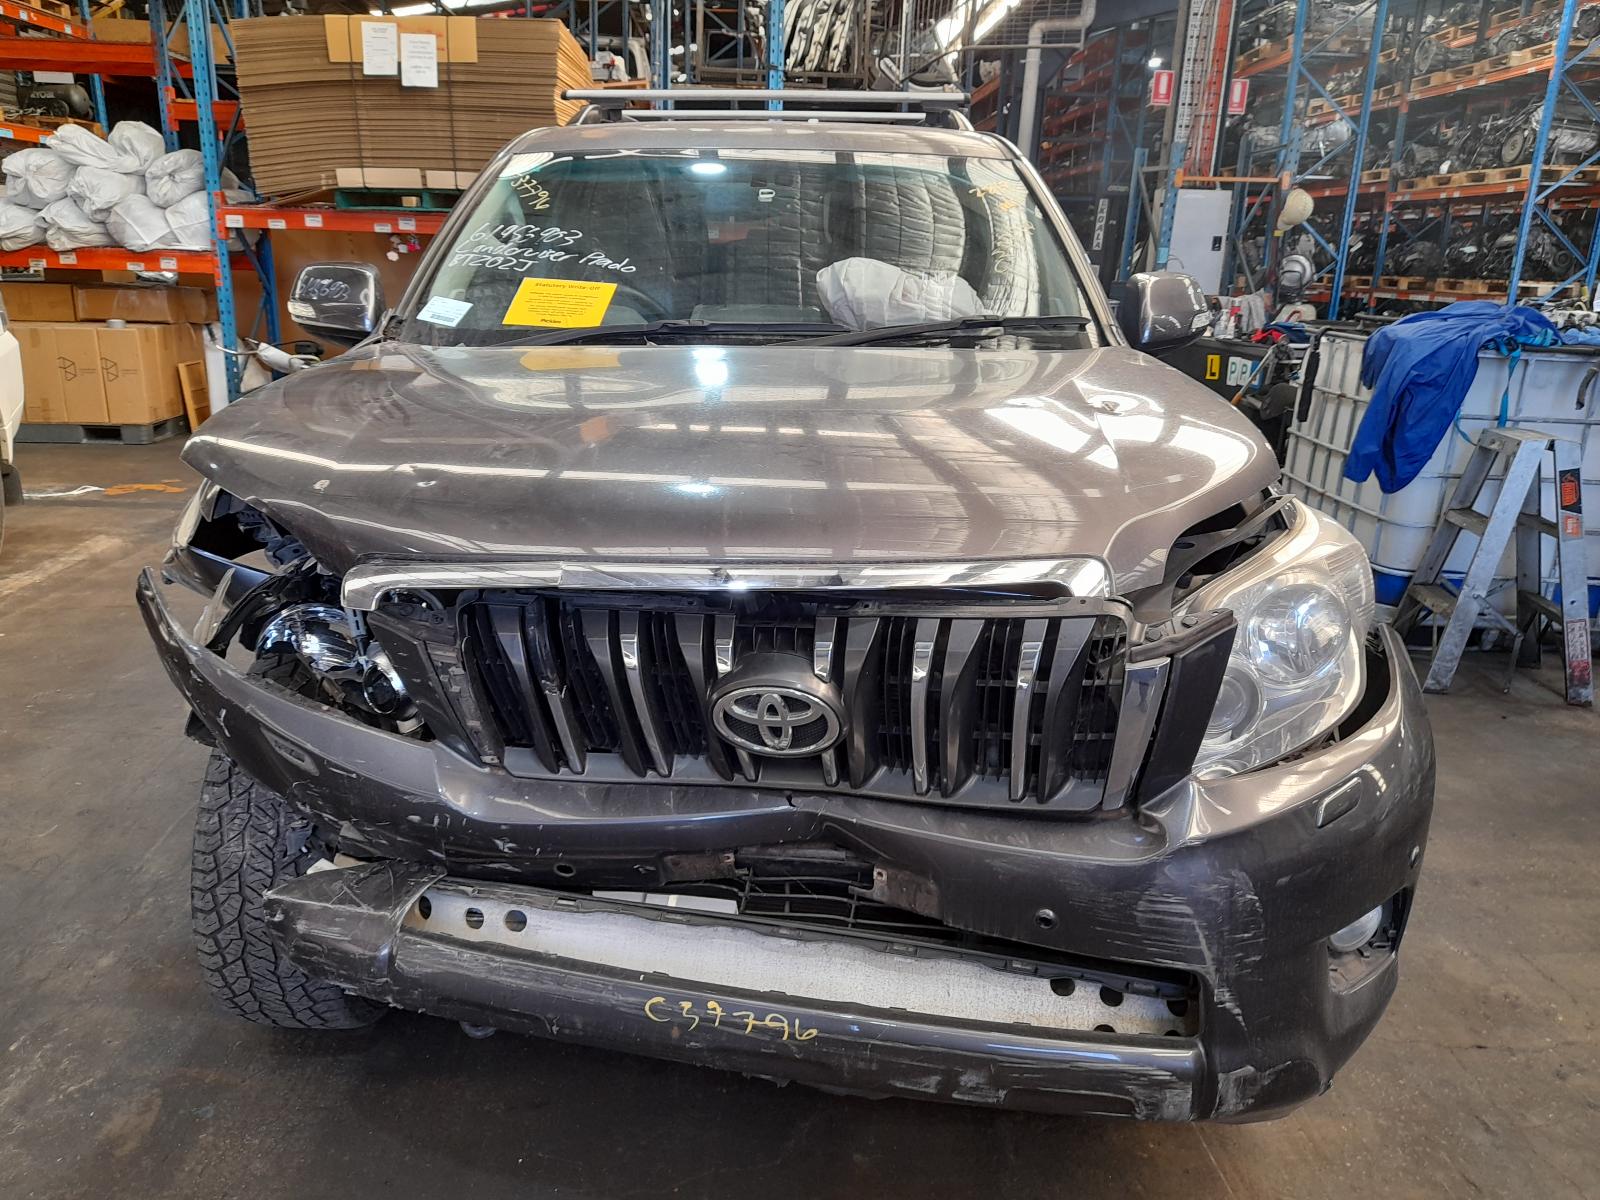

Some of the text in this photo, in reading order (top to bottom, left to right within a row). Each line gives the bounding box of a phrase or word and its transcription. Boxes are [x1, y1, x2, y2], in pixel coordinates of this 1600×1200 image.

[578, 251, 637, 273] Prado
[1209, 358, 1217, 377] L
[644, 996, 818, 1041] C37796
